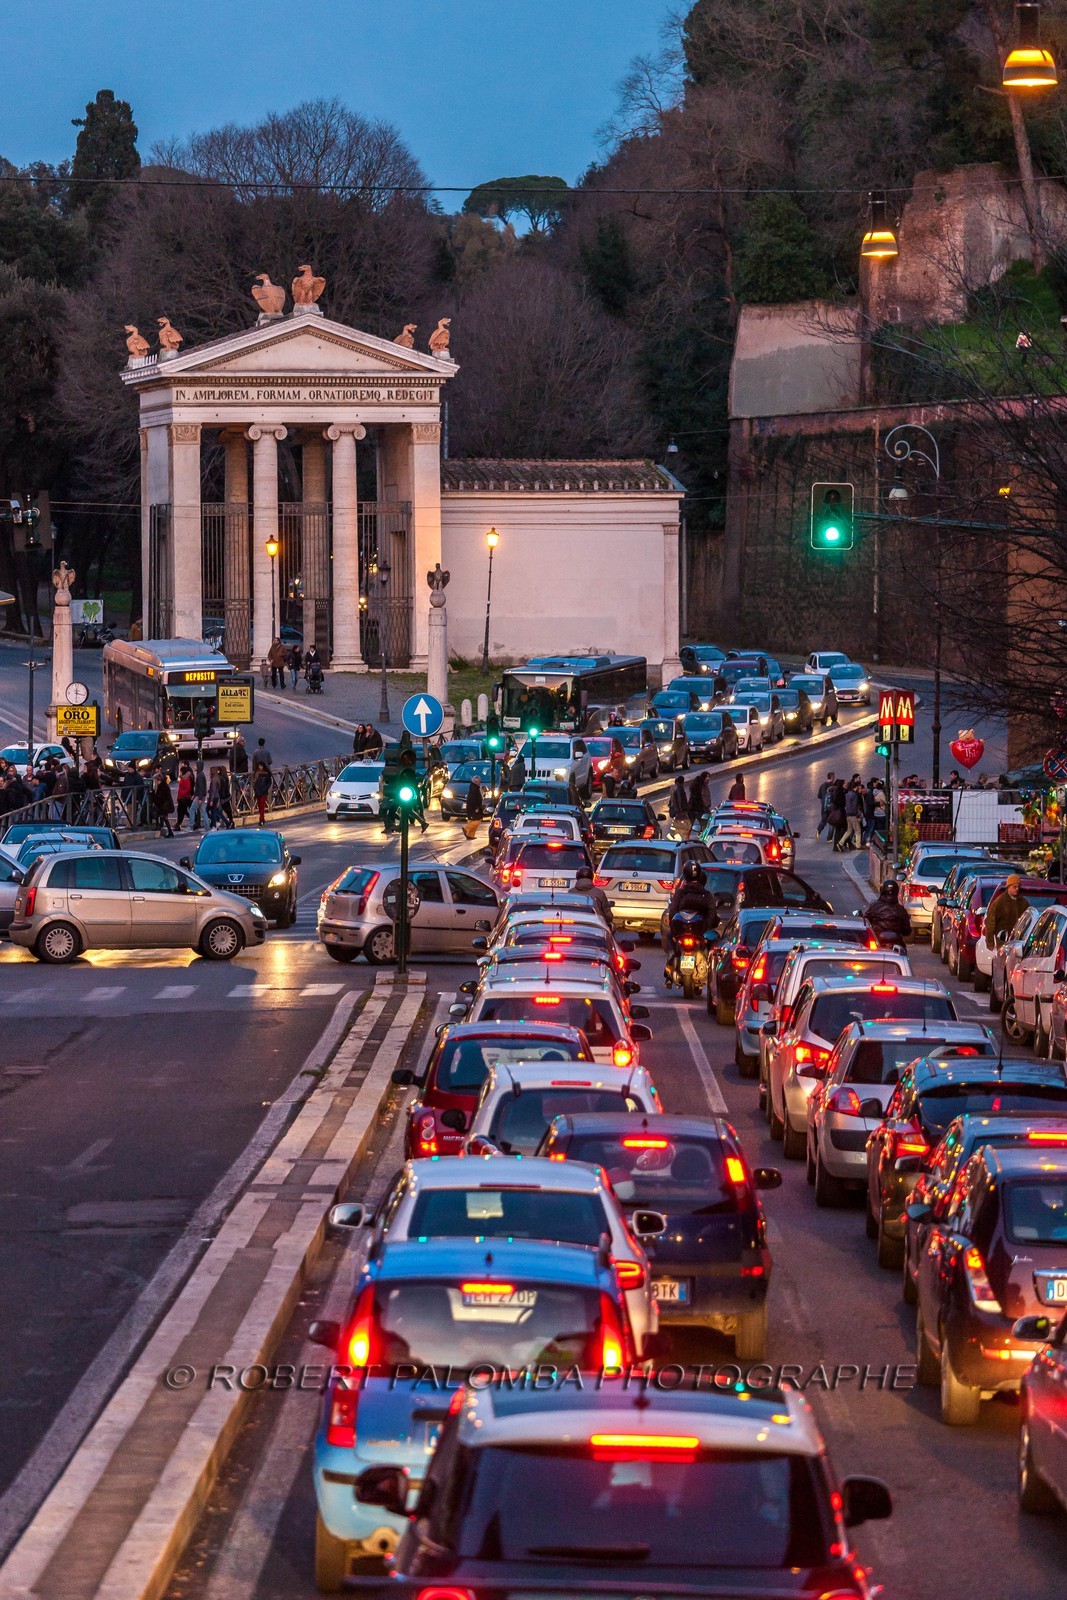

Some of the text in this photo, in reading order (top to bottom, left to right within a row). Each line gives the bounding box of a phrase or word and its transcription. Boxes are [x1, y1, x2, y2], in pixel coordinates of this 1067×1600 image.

[387, 390, 435, 400] REDEGIT
[185, 671, 215, 682] DEPOSITO
[880, 696, 894, 719] M
[896, 696, 913, 719] M
[63, 710, 90, 720] ORO
